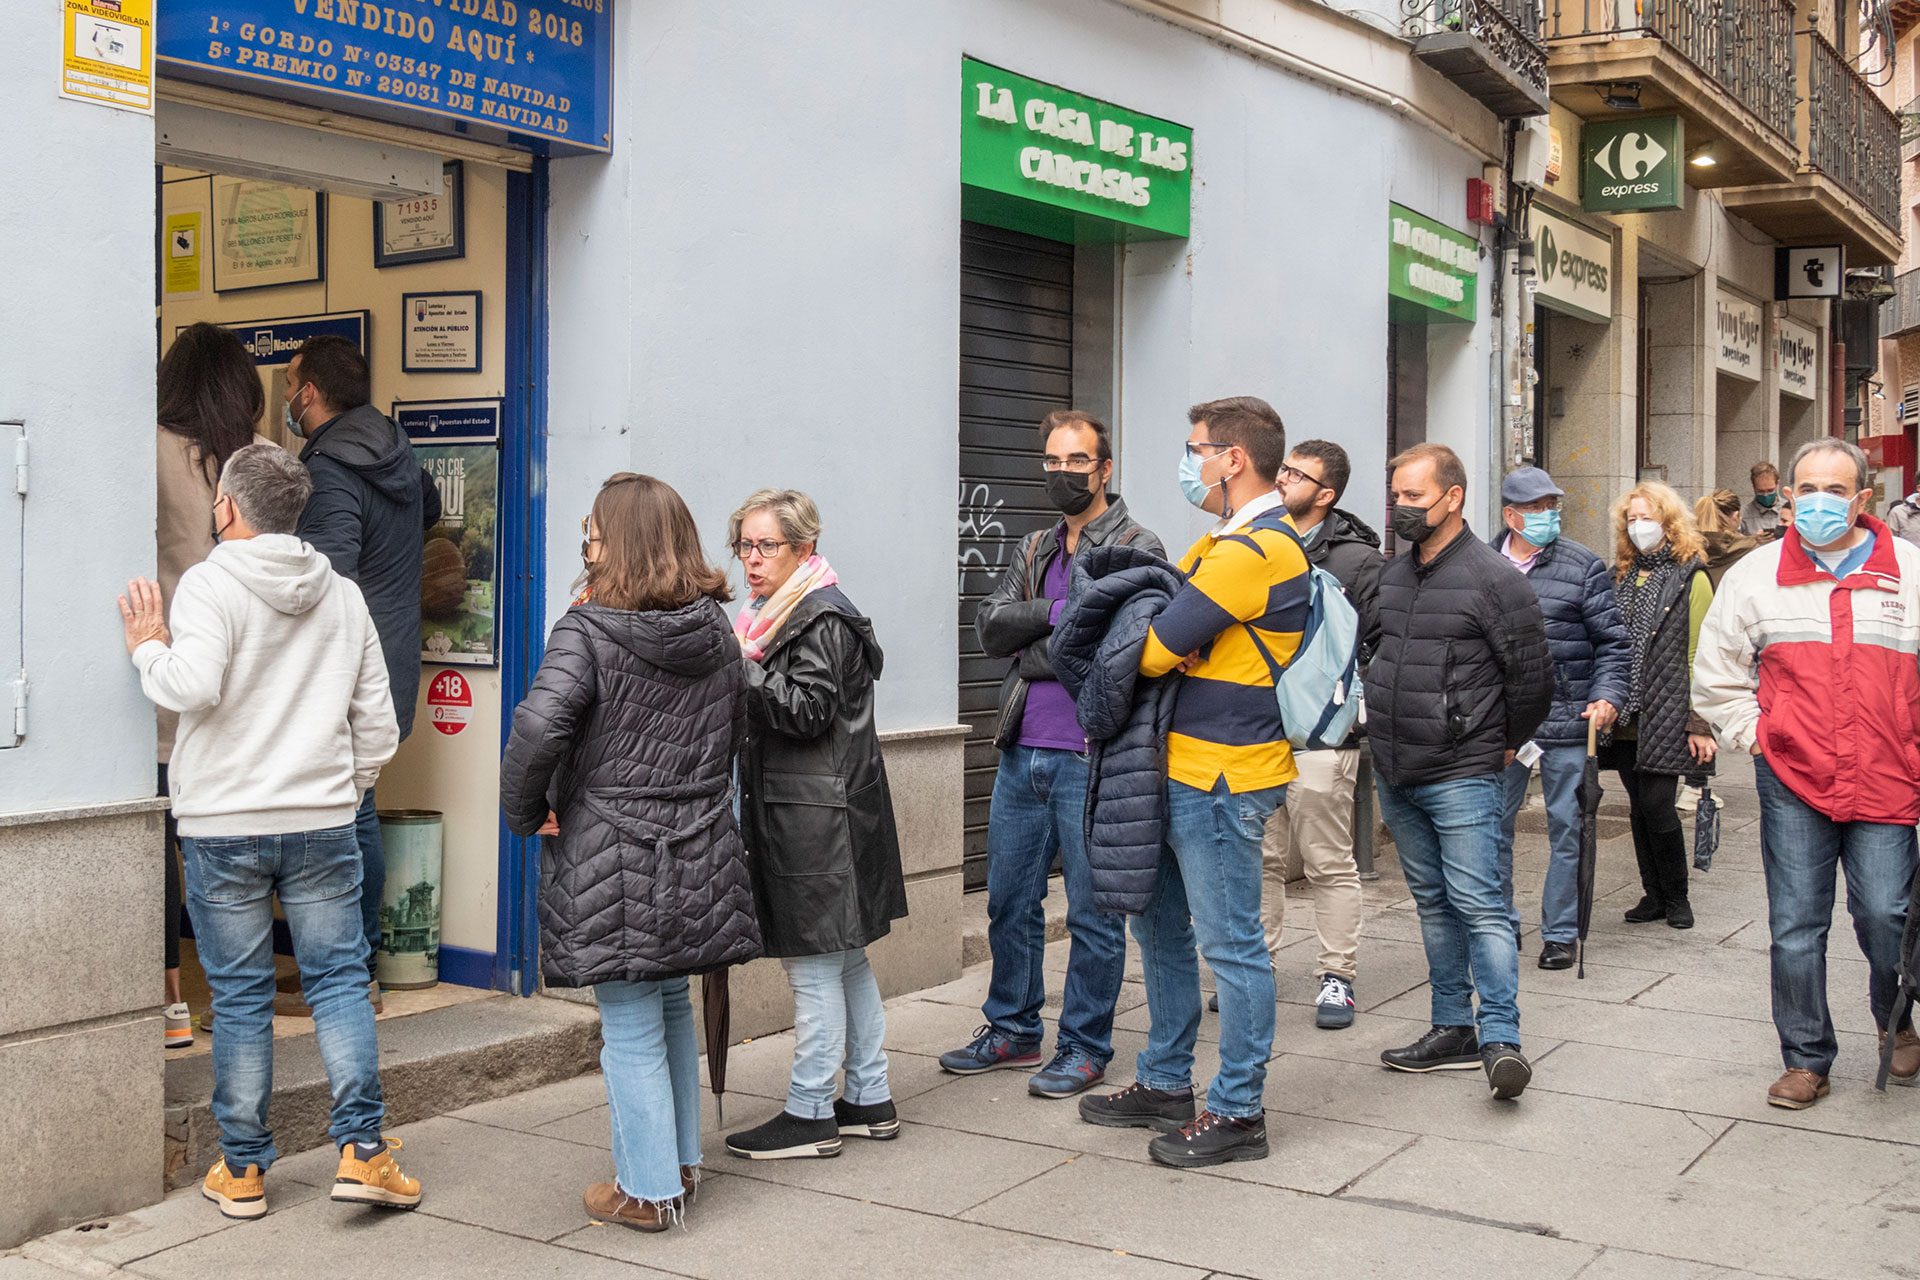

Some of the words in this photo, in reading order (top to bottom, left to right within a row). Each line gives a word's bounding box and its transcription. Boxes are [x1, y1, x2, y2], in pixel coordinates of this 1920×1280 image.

[67, 1, 89, 13] ZONA
[91, 7, 150, 27] VIDEOVIGILADA
[294, 0, 434, 44] VENDIDO
[447, 25, 516, 64] AQUÍ
[528, 8, 583, 47] 2018
[236, 47, 338, 82] PREMIO
[377, 76, 440, 103] 29031
[447, 91, 474, 111] DE
[480, 99, 569, 134] NAVIDAD
[240, 23, 333, 57] GORDO
[375, 52, 442, 80] 03347
[449, 69, 476, 89] DE
[482, 77, 571, 113] NAVIDAD
[976, 82, 1018, 124] LA
[1025, 98, 1095, 146] CASA
[1099, 120, 1134, 157] DE
[1139, 132, 1187, 171] LAS
[1020, 146, 1150, 207] CARCASAS
[1601, 182, 1659, 198] express
[398, 199, 438, 215] 71935
[1560, 249, 1608, 294] express
[436, 675, 462, 698] +18
